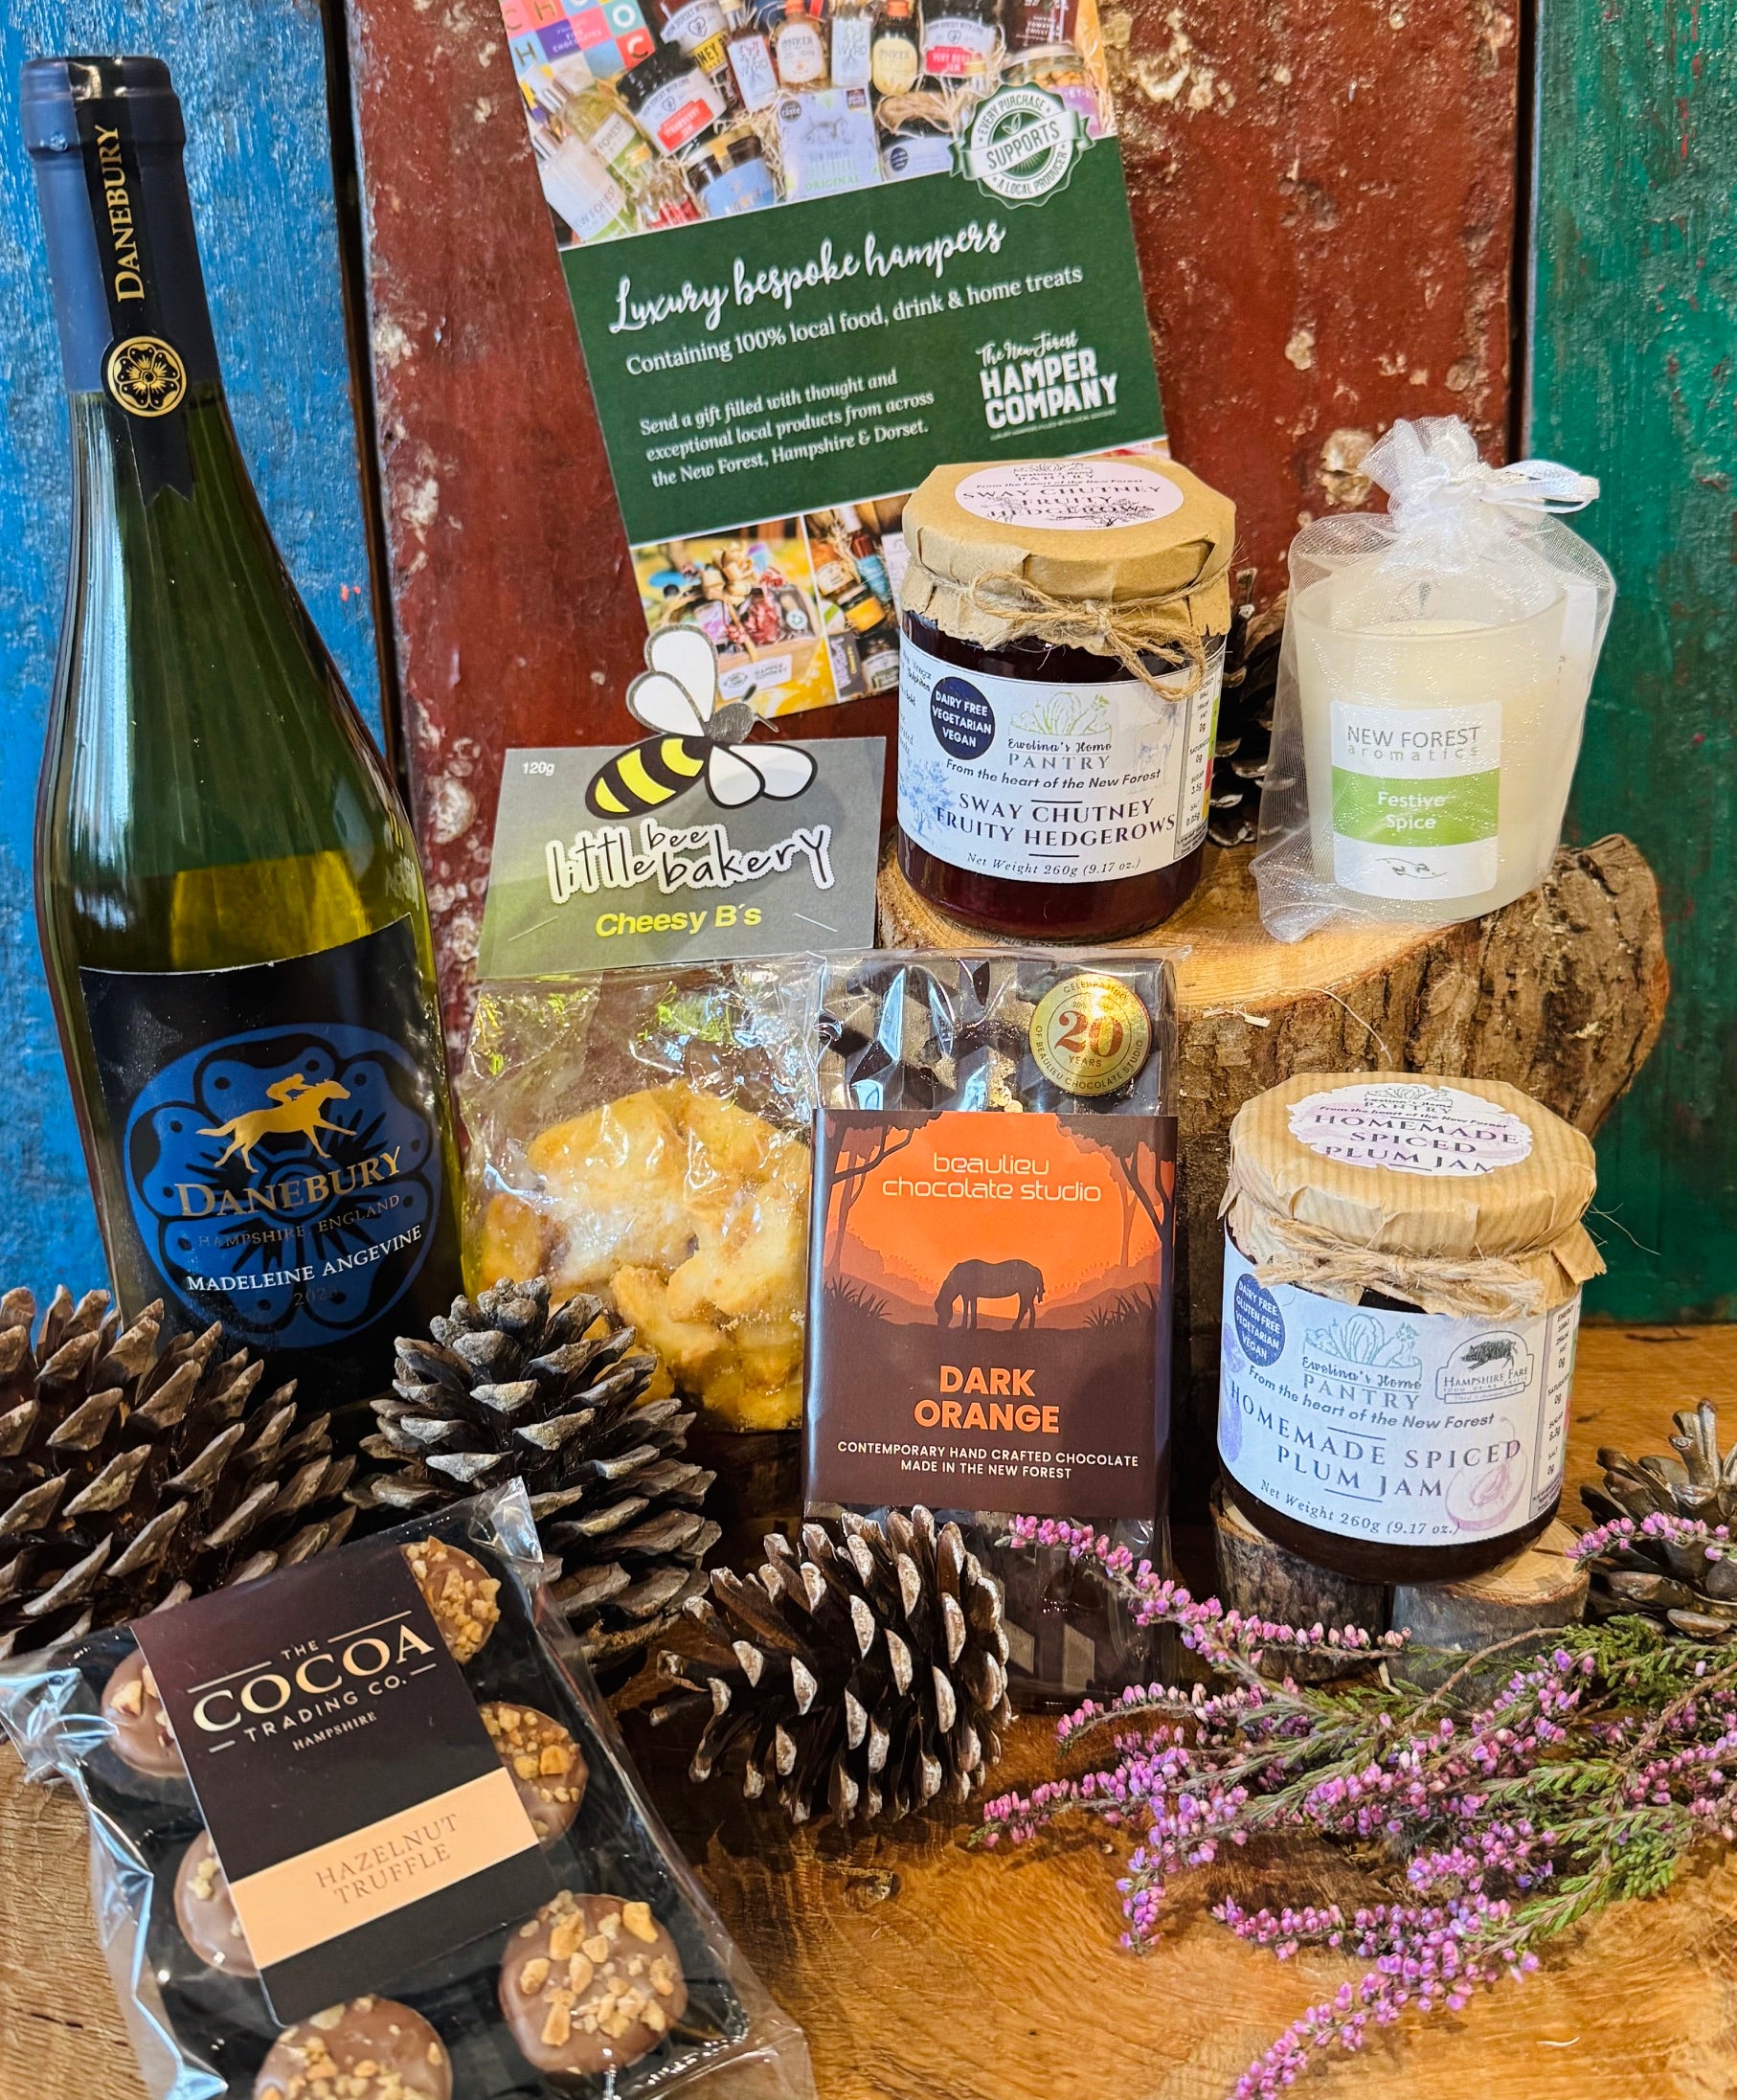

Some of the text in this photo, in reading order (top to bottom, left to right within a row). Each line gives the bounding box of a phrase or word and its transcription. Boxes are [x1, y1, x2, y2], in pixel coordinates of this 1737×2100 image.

[979, 95, 1046, 136] EVERY PURCHASE
[986, 121, 1060, 169] SUPPORTS
[805, 175, 859, 190] ORIGINAL
[998, 151, 1069, 195] A LOCAL PRODUCER
[98, 124, 145, 303] DANEBURY
[608, 218, 1005, 334] Luxury bespoke hampers
[626, 265, 1084, 375] Containing 100% local food, drink & home treats
[976, 328, 1079, 367] The New Forest
[980, 347, 1098, 400] HAMPER
[640, 366, 898, 436] Send a gift filled with thought and
[984, 372, 1118, 429] COMPANY
[645, 391, 936, 463] exceptional local products from across
[652, 418, 930, 488] the New Forest, Hampshire & Dorset.
[963, 486, 1161, 499] SWAY CHUTNEY
[1022, 497, 1111, 506] FRUITY
[932, 706, 992, 734] VEGETARIAN
[936, 690, 961, 709] DAIRY
[964, 701, 988, 716] FREE
[942, 727, 977, 748] VEGAN
[1347, 725, 1481, 749] NEW FOREST
[1347, 745, 1478, 761] aromatics
[522, 761, 554, 777] 120g
[946, 758, 1161, 789] From the heart of the New Forest
[1008, 754, 1112, 770] PANTRY
[959, 793, 1156, 824] SWAY CHUTNEY
[1377, 790, 1446, 808] Festive
[647, 824, 708, 848] bee
[936, 806, 1014, 843] FRUITY
[1025, 814, 1175, 847] HEDGEROWS
[1385, 814, 1436, 833] Spice
[553, 829, 824, 897] little bakery
[967, 852, 1141, 877] Net Weight 260g (9.17 oz.)
[596, 910, 707, 937] Cheesy
[1053, 1010, 1123, 1058] 20
[1035, 1025, 1143, 1090] OF BEAULIEU CHOCOLATE STUDIO
[1069, 1055, 1102, 1068] YEARS
[1365, 1102, 1452, 1114] PANTRY
[1315, 1115, 1520, 1144] HOMEMADE
[1350, 1132, 1476, 1153] SPICED
[934, 1152, 1049, 1176] beaulieu
[1325, 1145, 1420, 1163] PLUM
[175, 1146, 401, 1218] DANEBURY
[882, 1178, 1101, 1202] chocolate studio
[199, 1194, 400, 1247] HAMPSHIRE ENGLAND
[187, 1225, 423, 1292] MADELEINE ANGEVINE
[1235, 1296, 1280, 1334] GLUTEN FREE
[1238, 1281, 1278, 1317] DAIRY FREE
[1235, 1310, 1279, 1349] VEGETARIAN
[1242, 1331, 1268, 1360] VEGAN
[939, 1365, 1036, 1398] DARK
[1302, 1373, 1420, 1411] PANTRY
[1444, 1366, 1527, 1388] HAMPSHIRE FARE
[1249, 1365, 1495, 1429] From the heart of the New Forest
[914, 1399, 1060, 1434] ORANGE
[1230, 1381, 1521, 1470] HOMEMADE SPICED
[837, 1440, 1139, 1467] CONTEMPORARY HAND CRAFTED CHOCOLATE
[900, 1459, 1072, 1479] MADE IN THE NEW FOREST
[1277, 1445, 1443, 1498] PLUM JAM
[1261, 1479, 1460, 1536] Net Weight 260g (9.17 oz.)
[282, 1639, 319, 1660] THE
[192, 1624, 435, 1732] COCOA
[243, 1676, 407, 1745] TRADING CO.
[291, 1711, 378, 1750] HAMPSHIRE
[314, 1814, 459, 1888] HAZELNUT
[333, 1843, 452, 1906] TRUFFLE
